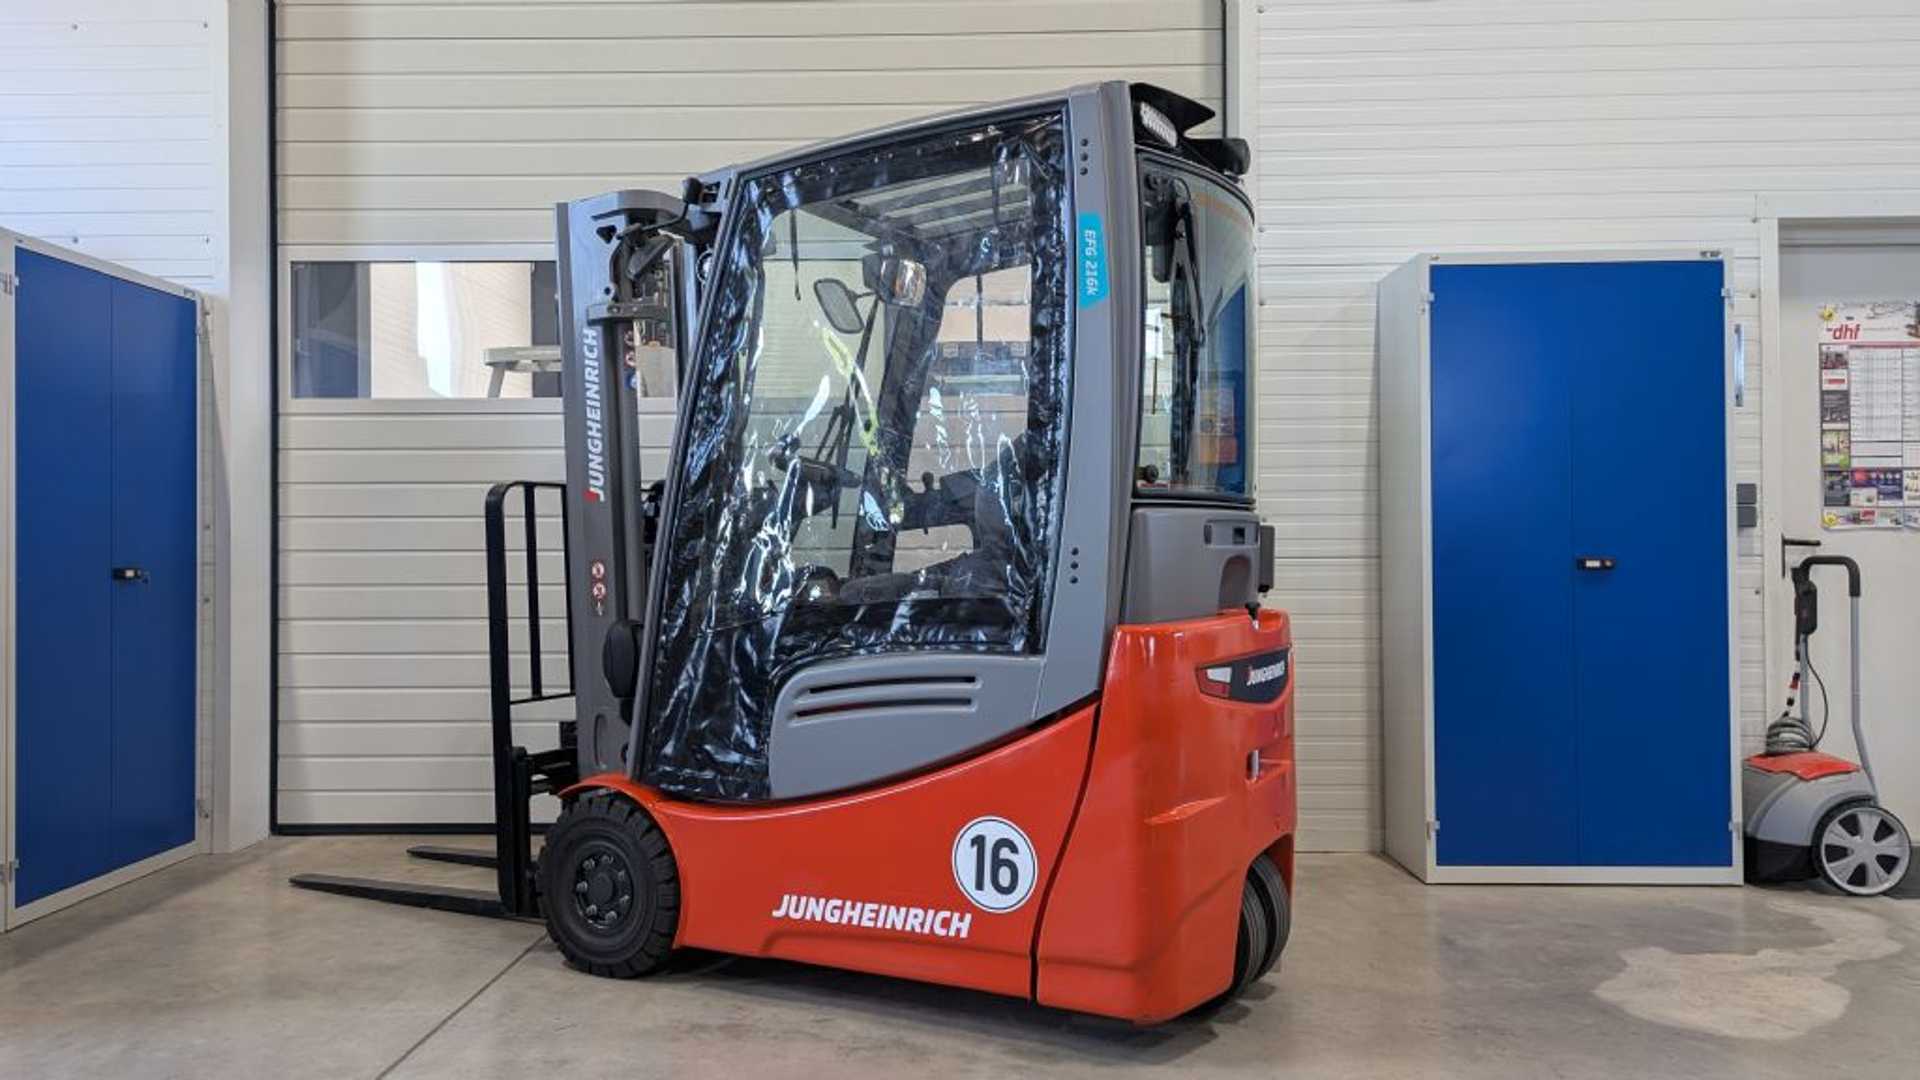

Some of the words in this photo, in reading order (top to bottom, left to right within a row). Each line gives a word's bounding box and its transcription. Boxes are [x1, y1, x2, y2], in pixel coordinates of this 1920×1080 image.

[1084, 229, 1097, 256] EFG
[1832, 323, 1860, 340] dhf
[583, 328, 605, 502] JUNGHEINRICH
[970, 834, 1019, 896] 16
[772, 894, 972, 938] JUNGHEINRICH
